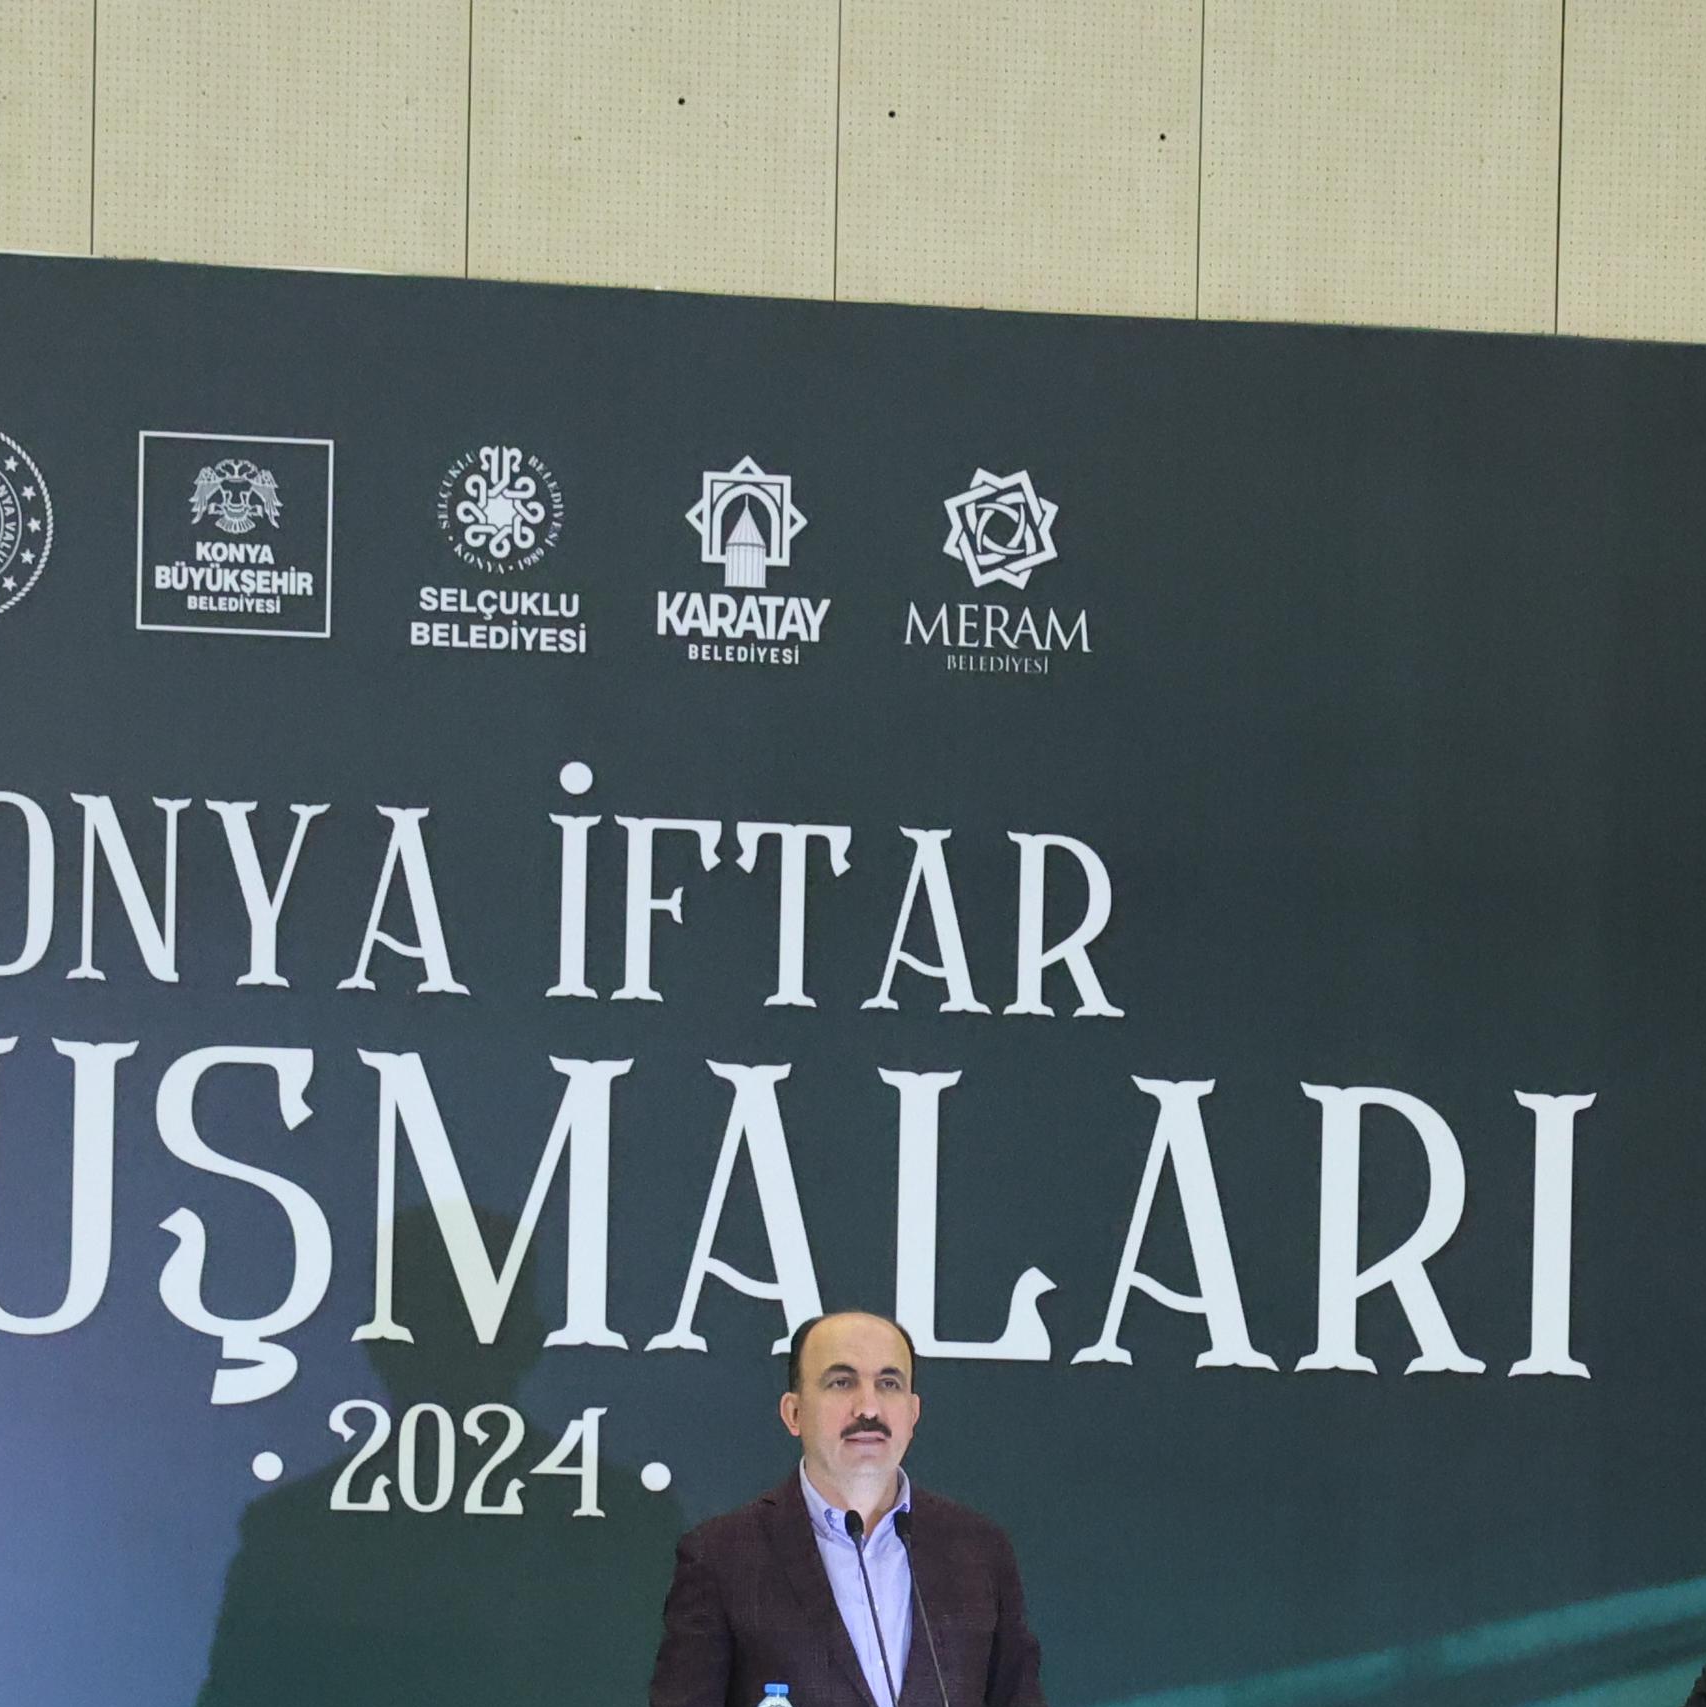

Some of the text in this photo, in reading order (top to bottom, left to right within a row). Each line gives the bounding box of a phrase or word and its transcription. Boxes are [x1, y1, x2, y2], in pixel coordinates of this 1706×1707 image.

[195, 541, 275, 567] KONYA
[517, 547, 545, 570] 1989
[155, 561, 313, 601] BÜYÜKŞEHİR
[187, 593, 281, 614] BELEDİYESİ
[419, 586, 579, 620] SELÇUKLU
[657, 590, 831, 642] KARATAY
[410, 619, 586, 653] BELEDİYESİ
[904, 601, 1091, 653] MERAM
[688, 642, 799, 665] BELEDİYESİ
[947, 654, 1048, 674] BELEDİYESİ
[545, 761, 1125, 1018] İFTAR
[328, 1398, 608, 1518] 2024
